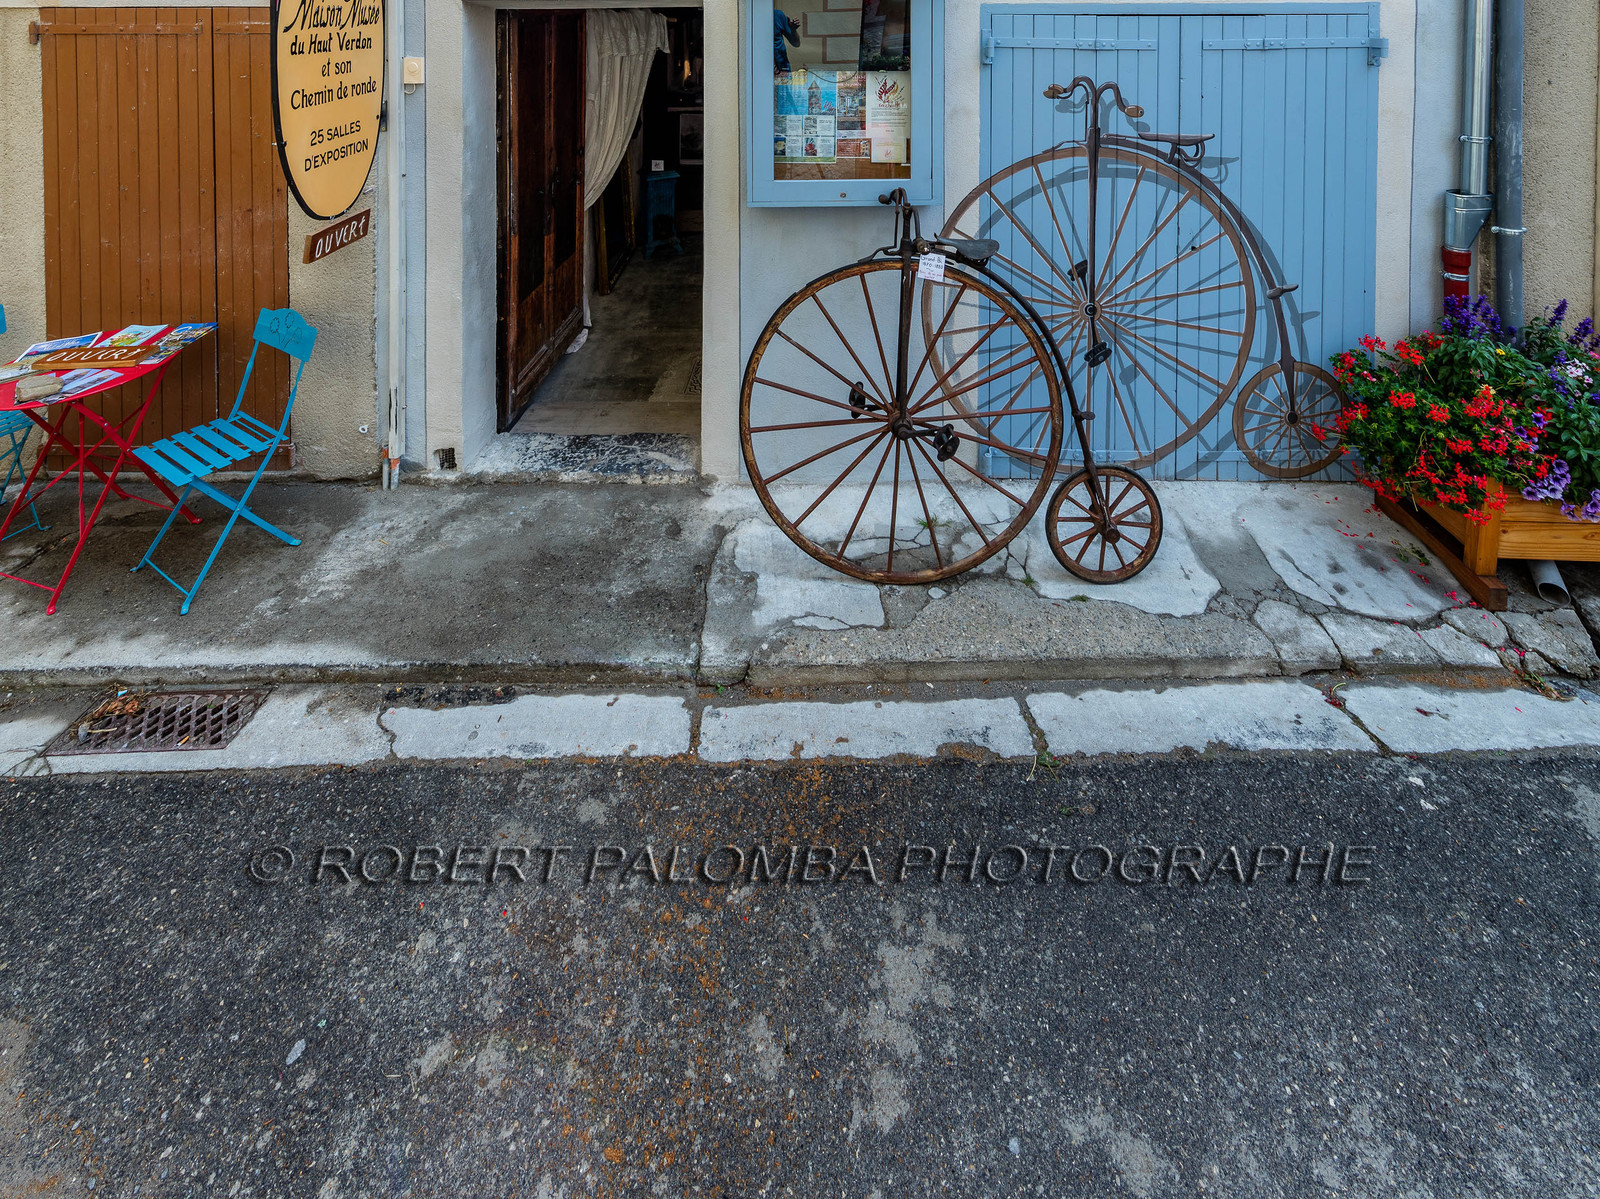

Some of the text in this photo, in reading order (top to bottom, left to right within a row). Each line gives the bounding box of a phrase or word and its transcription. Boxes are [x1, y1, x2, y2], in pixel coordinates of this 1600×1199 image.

[290, 31, 372, 55] du Haut Verdon
[321, 58, 352, 77] et son
[290, 76, 377, 110] Chemin de ronde
[310, 120, 361, 146] 25 SALLES
[304, 138, 369, 172] D'EXPOSITION
